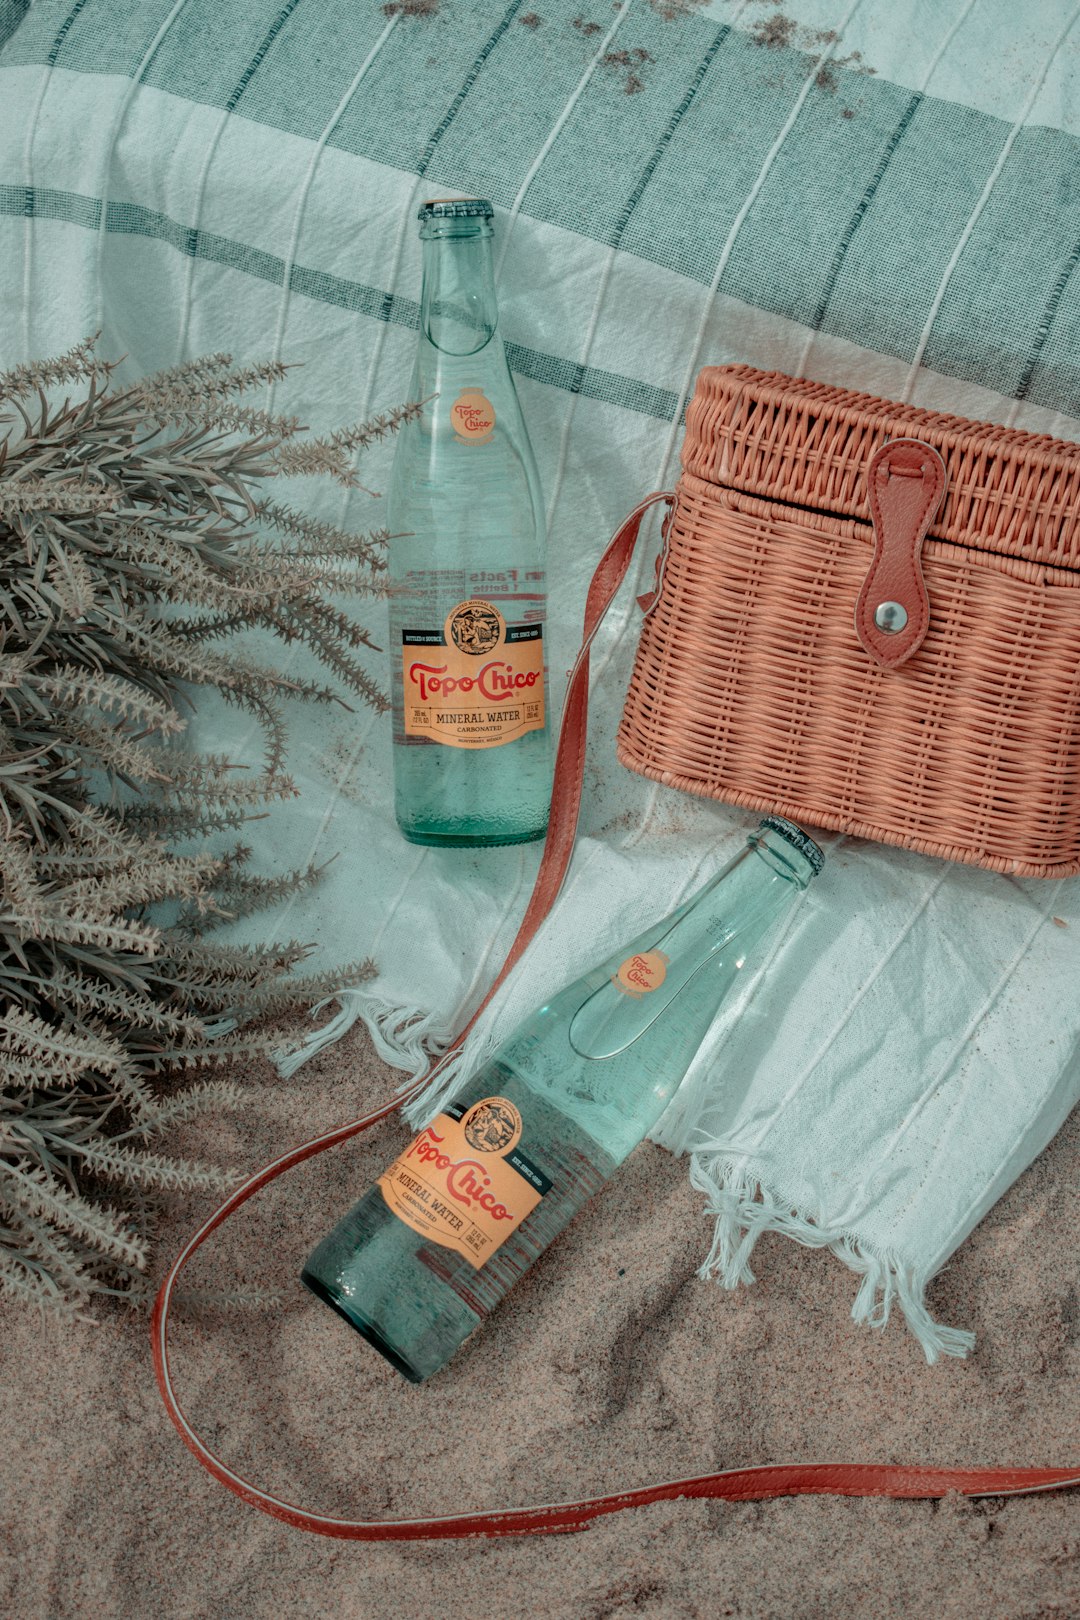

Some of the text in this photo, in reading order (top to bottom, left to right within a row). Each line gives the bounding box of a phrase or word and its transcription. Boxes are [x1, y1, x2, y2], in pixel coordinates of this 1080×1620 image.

[454, 405, 484, 419] Topo
[465, 417, 492, 431] Chico
[410, 662, 540, 701] Topo Chico
[436, 712, 520, 724] MINERAL WATER
[457, 725, 502, 733] CARBONATED
[632, 956, 654, 975] Topo
[627, 969, 652, 988] Chico
[406, 1126, 454, 1170] Topo
[446, 1160, 514, 1222] Chico
[396, 1171, 432, 1204] MINERAL
[430, 1198, 464, 1232] WATER
[401, 1192, 437, 1223] CARBONATED
